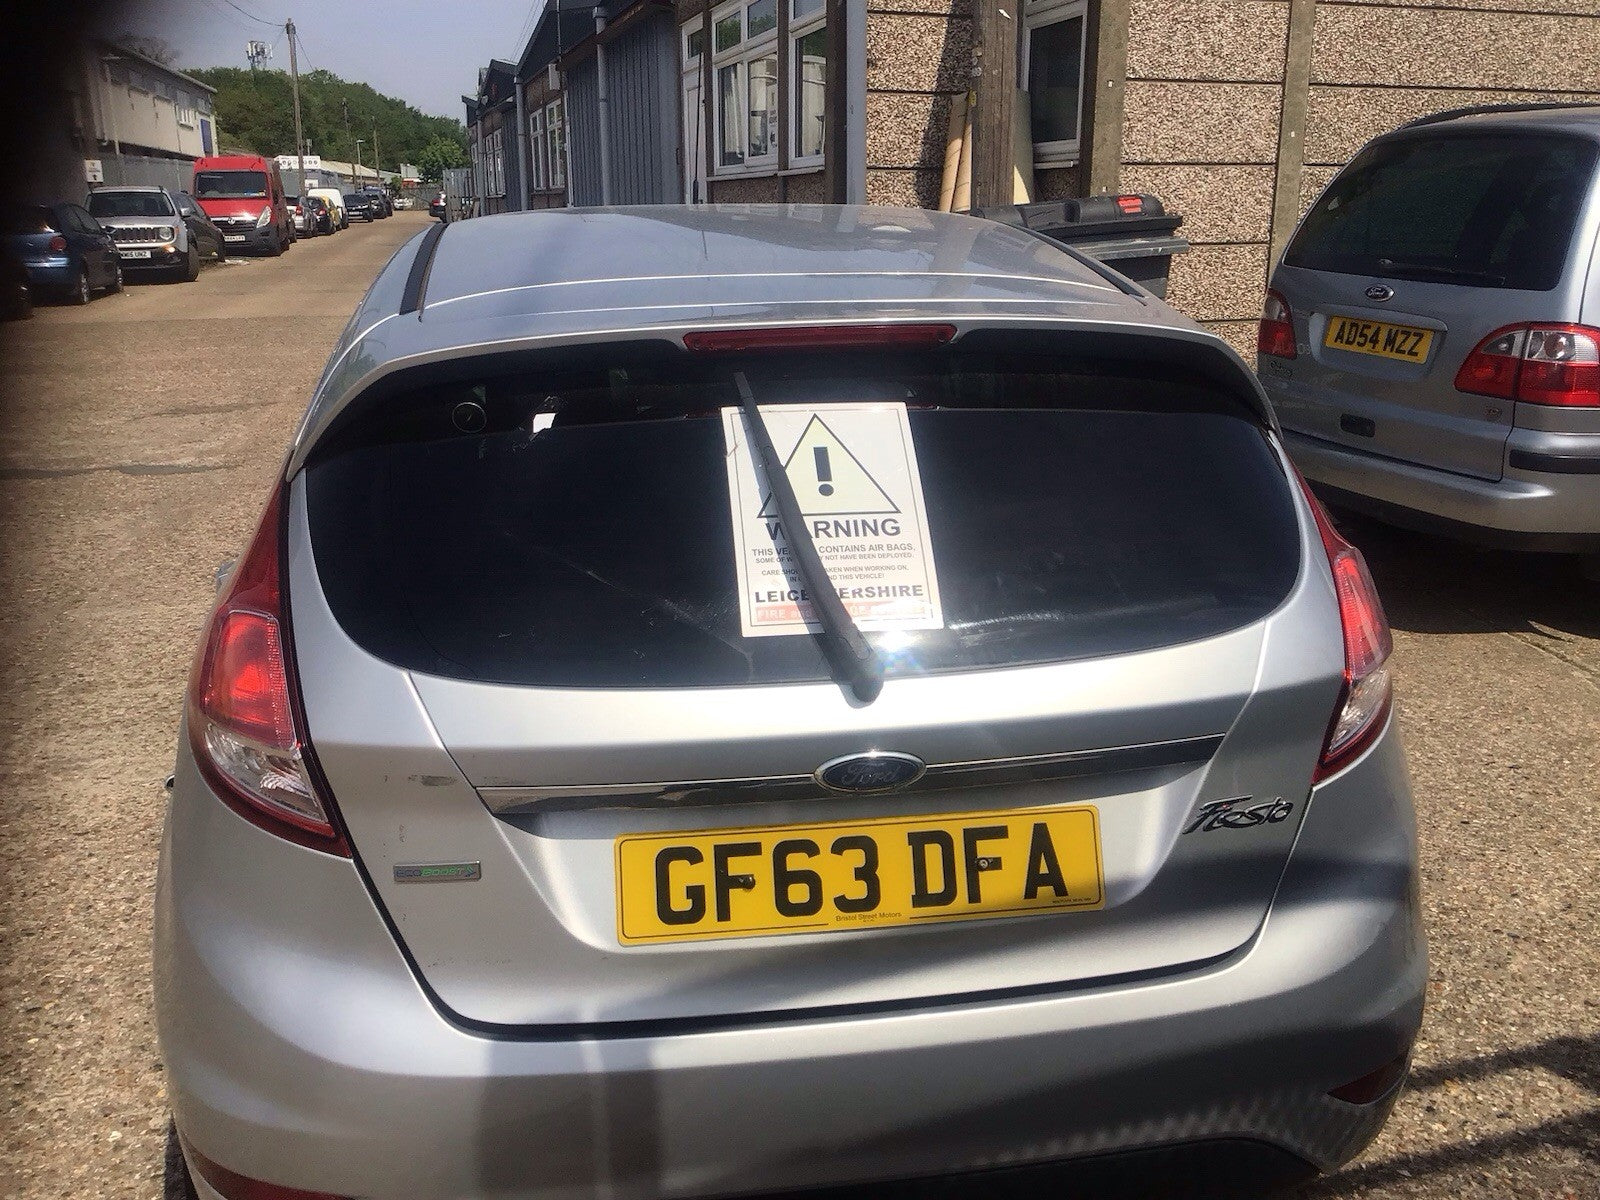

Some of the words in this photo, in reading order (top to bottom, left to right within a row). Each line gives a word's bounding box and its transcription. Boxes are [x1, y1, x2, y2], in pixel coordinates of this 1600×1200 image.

[1334, 320, 1381, 350] AD54
[1383, 328, 1424, 357] MZZ
[765, 518, 901, 541] WRNING
[752, 548, 774, 557] THIS
[819, 544, 866, 554] CONTAINS
[868, 543, 884, 552] AIR
[755, 585, 923, 602] LEICEERSHIRE
[757, 608, 785, 620] FIRE
[1182, 794, 1294, 835] Fiesta
[654, 834, 881, 926] GF63
[906, 822, 1069, 909] DFA
